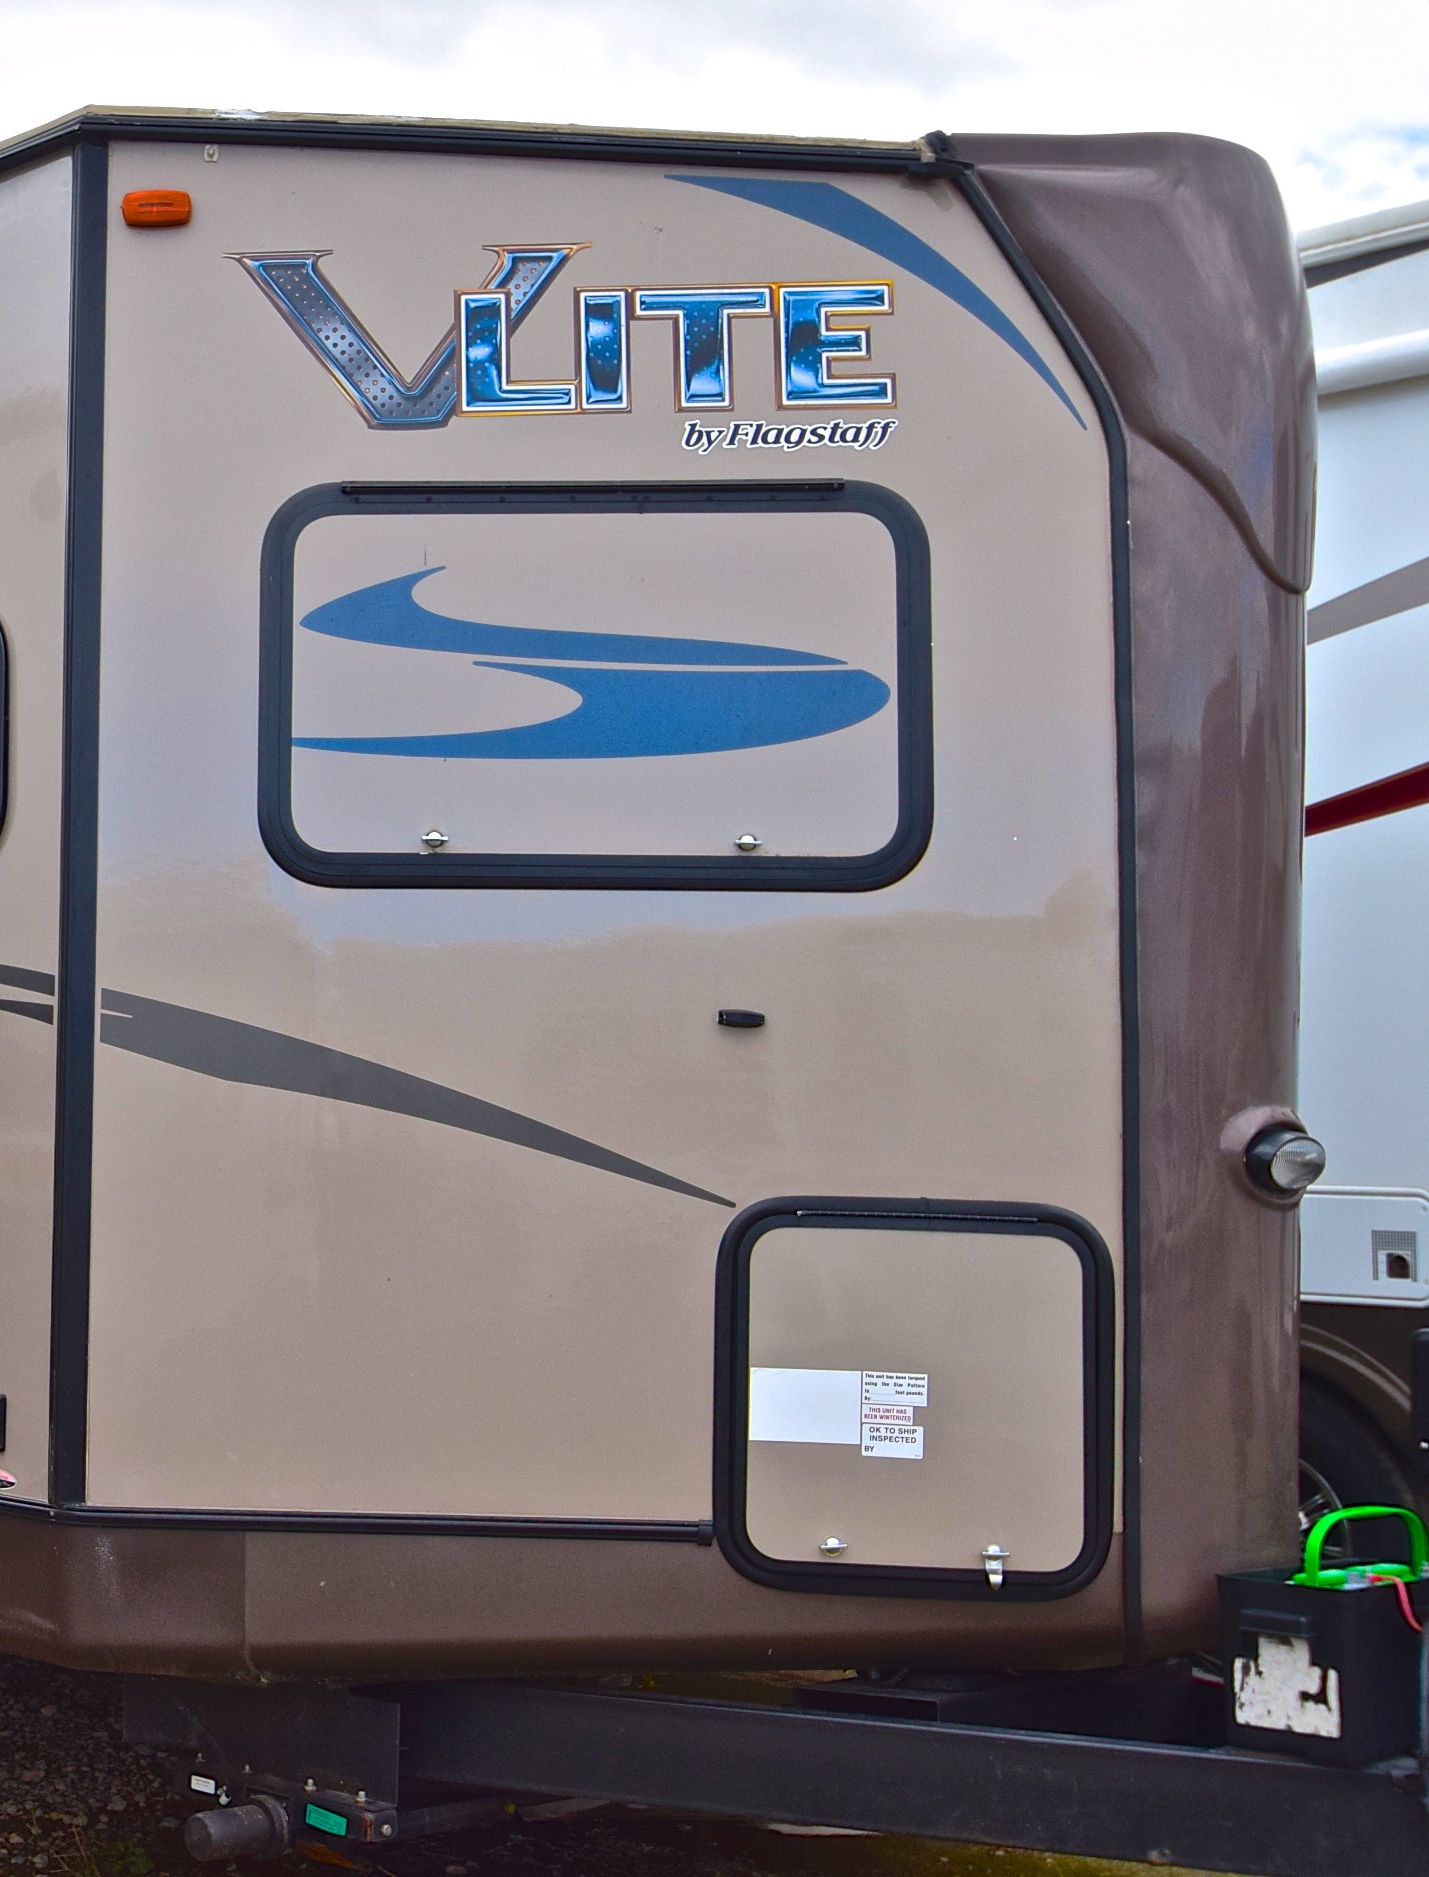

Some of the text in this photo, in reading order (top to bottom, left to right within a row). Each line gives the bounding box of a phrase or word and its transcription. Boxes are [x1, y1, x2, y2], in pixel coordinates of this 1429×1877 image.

[682, 418, 898, 455] by Flagstaff
[869, 1435, 916, 1443] INSPECTED
